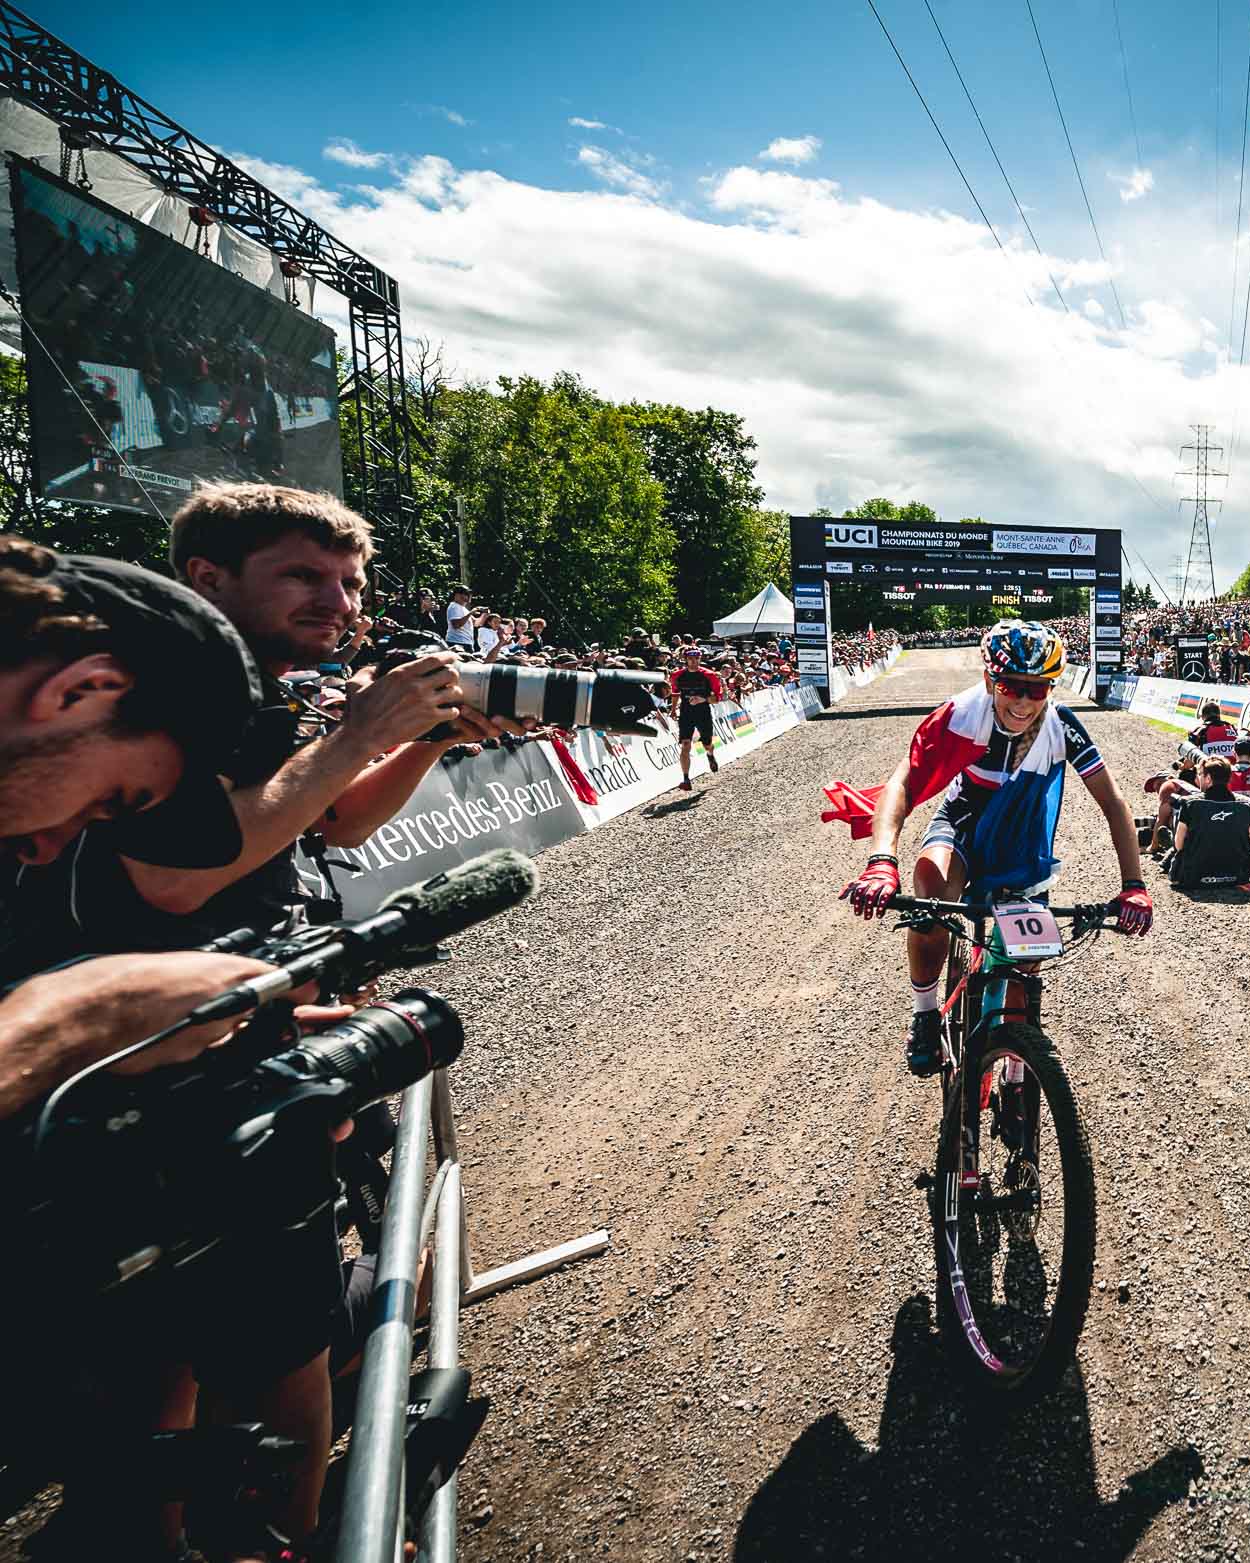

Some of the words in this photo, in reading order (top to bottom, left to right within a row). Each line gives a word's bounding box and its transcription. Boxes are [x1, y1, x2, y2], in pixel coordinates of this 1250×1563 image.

[834, 528, 873, 545] UCI
[881, 529, 944, 540] CHAMPIONNATS
[946, 532, 957, 540] DU
[958, 533, 989, 541] MONDE
[881, 538, 925, 547] MOUNTAIN
[926, 539, 943, 547] BIKE
[944, 540, 961, 549] 2019
[1029, 542, 1057, 552] CANADA
[882, 592, 916, 600] TISSOT
[992, 595, 1020, 605] FINISH
[1022, 595, 1054, 603] TISSOT
[643, 740, 680, 771] Cana
[339, 778, 562, 879] Mercedes-Benz
[1014, 917, 1043, 937] 10
[360, 1183, 382, 1224] Canon
